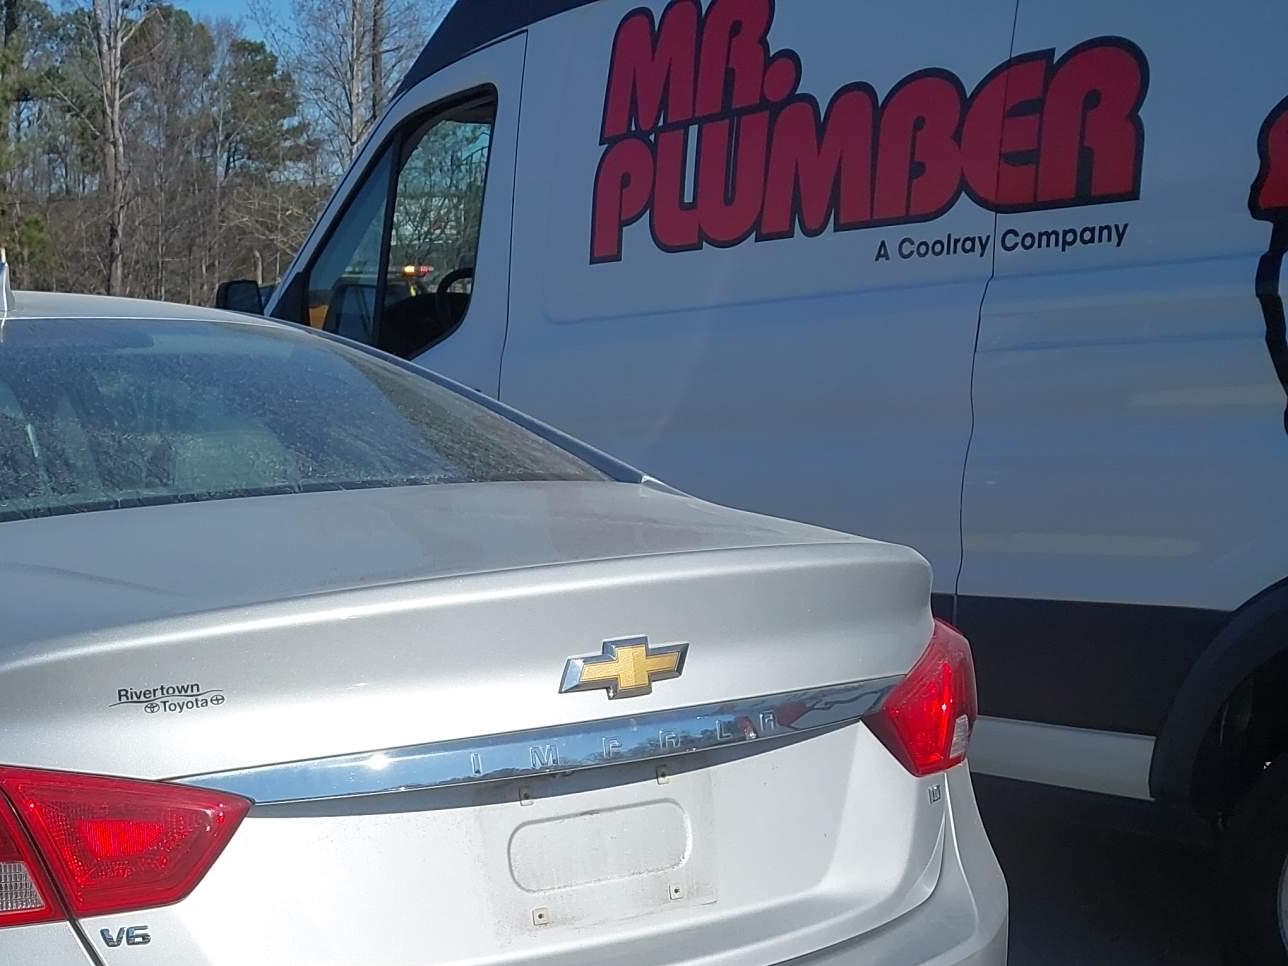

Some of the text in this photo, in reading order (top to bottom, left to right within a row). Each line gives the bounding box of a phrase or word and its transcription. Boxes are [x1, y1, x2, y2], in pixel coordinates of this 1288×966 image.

[599, 0, 802, 145] MR.
[589, 36, 1149, 264] PLUMBER
[874, 223, 1129, 261] A Coolray Company
[117, 683, 200, 702] Rivertown
[161, 697, 208, 714] Toyota
[470, 710, 776, 776] IMPALA
[100, 925, 151, 947] V6
